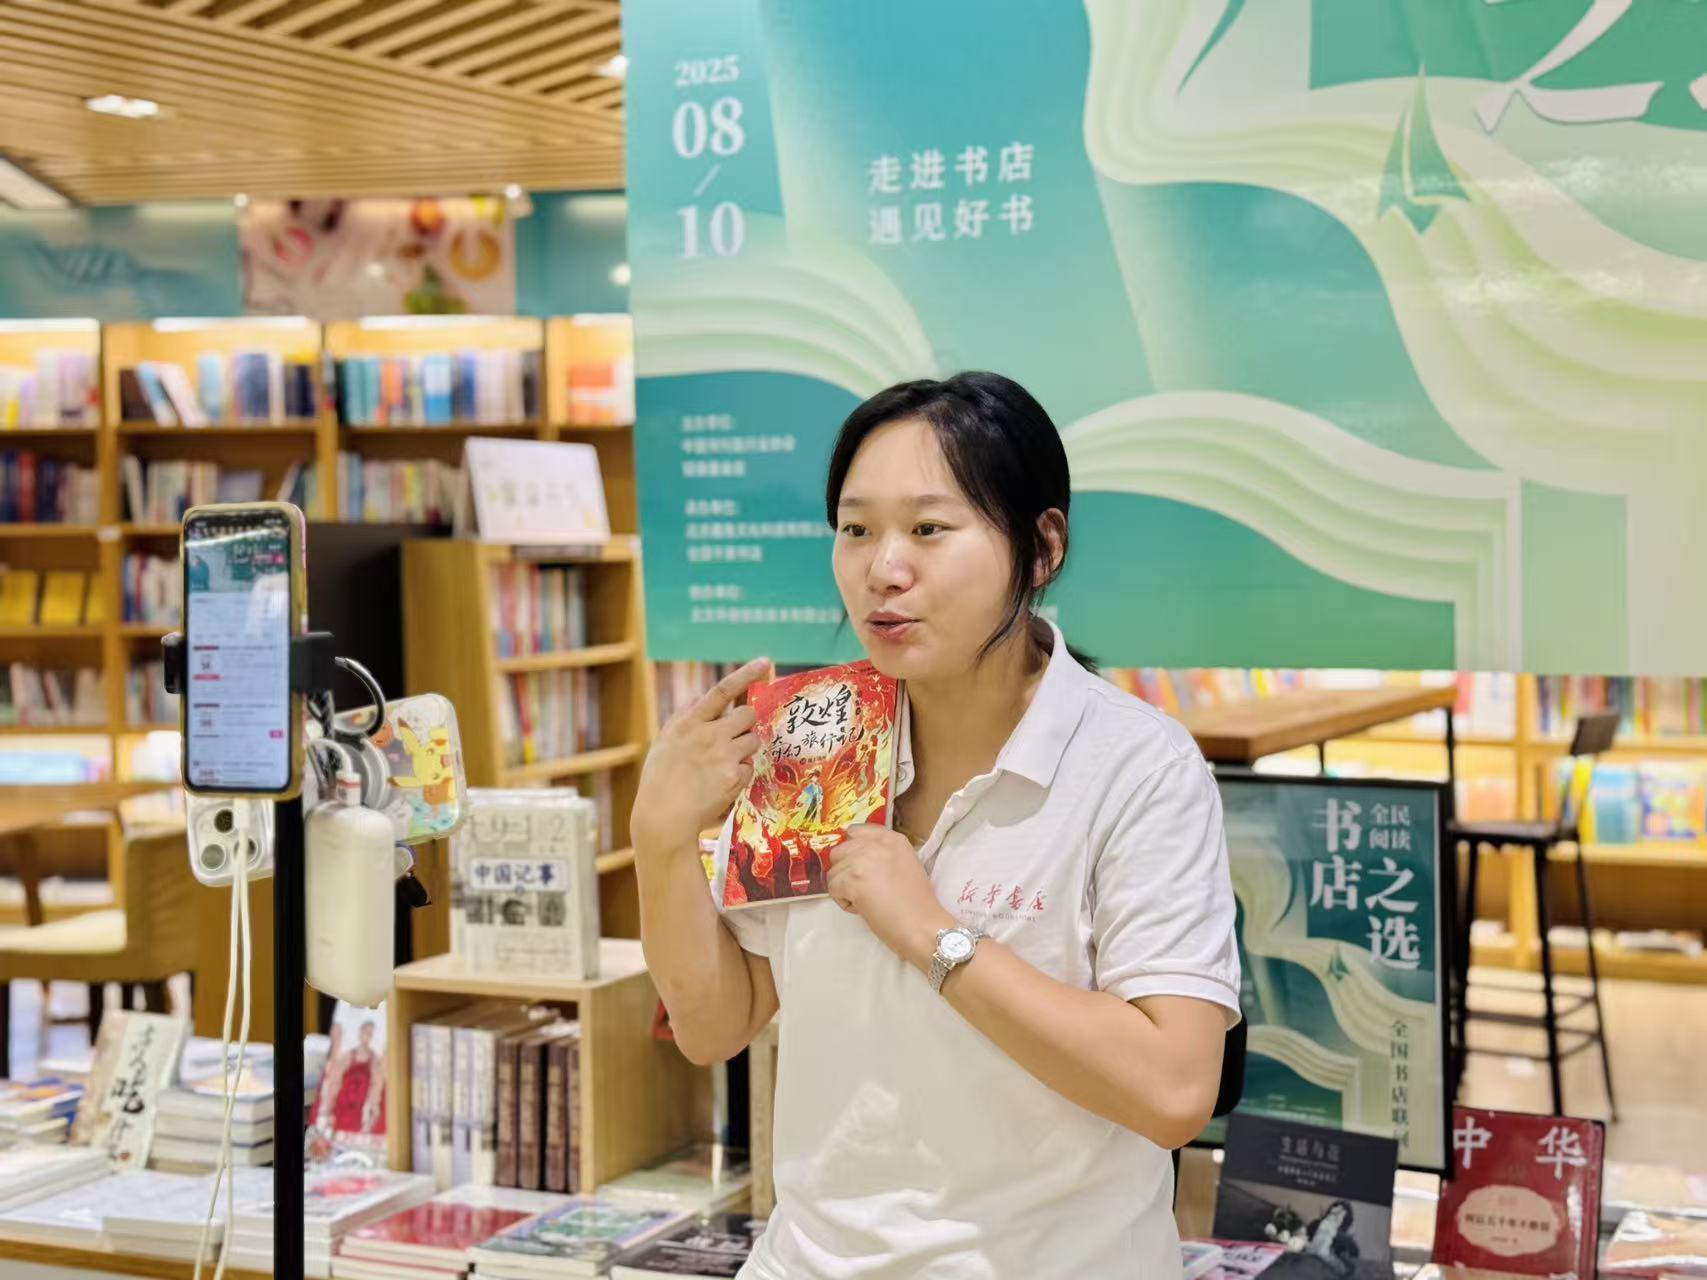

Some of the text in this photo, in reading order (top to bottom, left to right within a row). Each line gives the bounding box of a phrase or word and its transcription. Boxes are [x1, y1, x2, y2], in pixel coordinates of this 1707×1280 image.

[675, 55, 740, 88] 2025
[672, 97, 745, 158] 08
[868, 141, 1034, 194] 走进书店
[677, 201, 745, 259] 10
[868, 194, 1034, 245] 遇见好书
[783, 684, 852, 735] 敦煌
[1369, 803, 1411, 827] 全民
[1369, 828, 1412, 851] 阅读
[475, 863, 555, 885] 中国记事
[1310, 798, 1363, 911] 书店
[957, 879, 1047, 911] 新华书店
[1364, 857, 1421, 970] 之选
